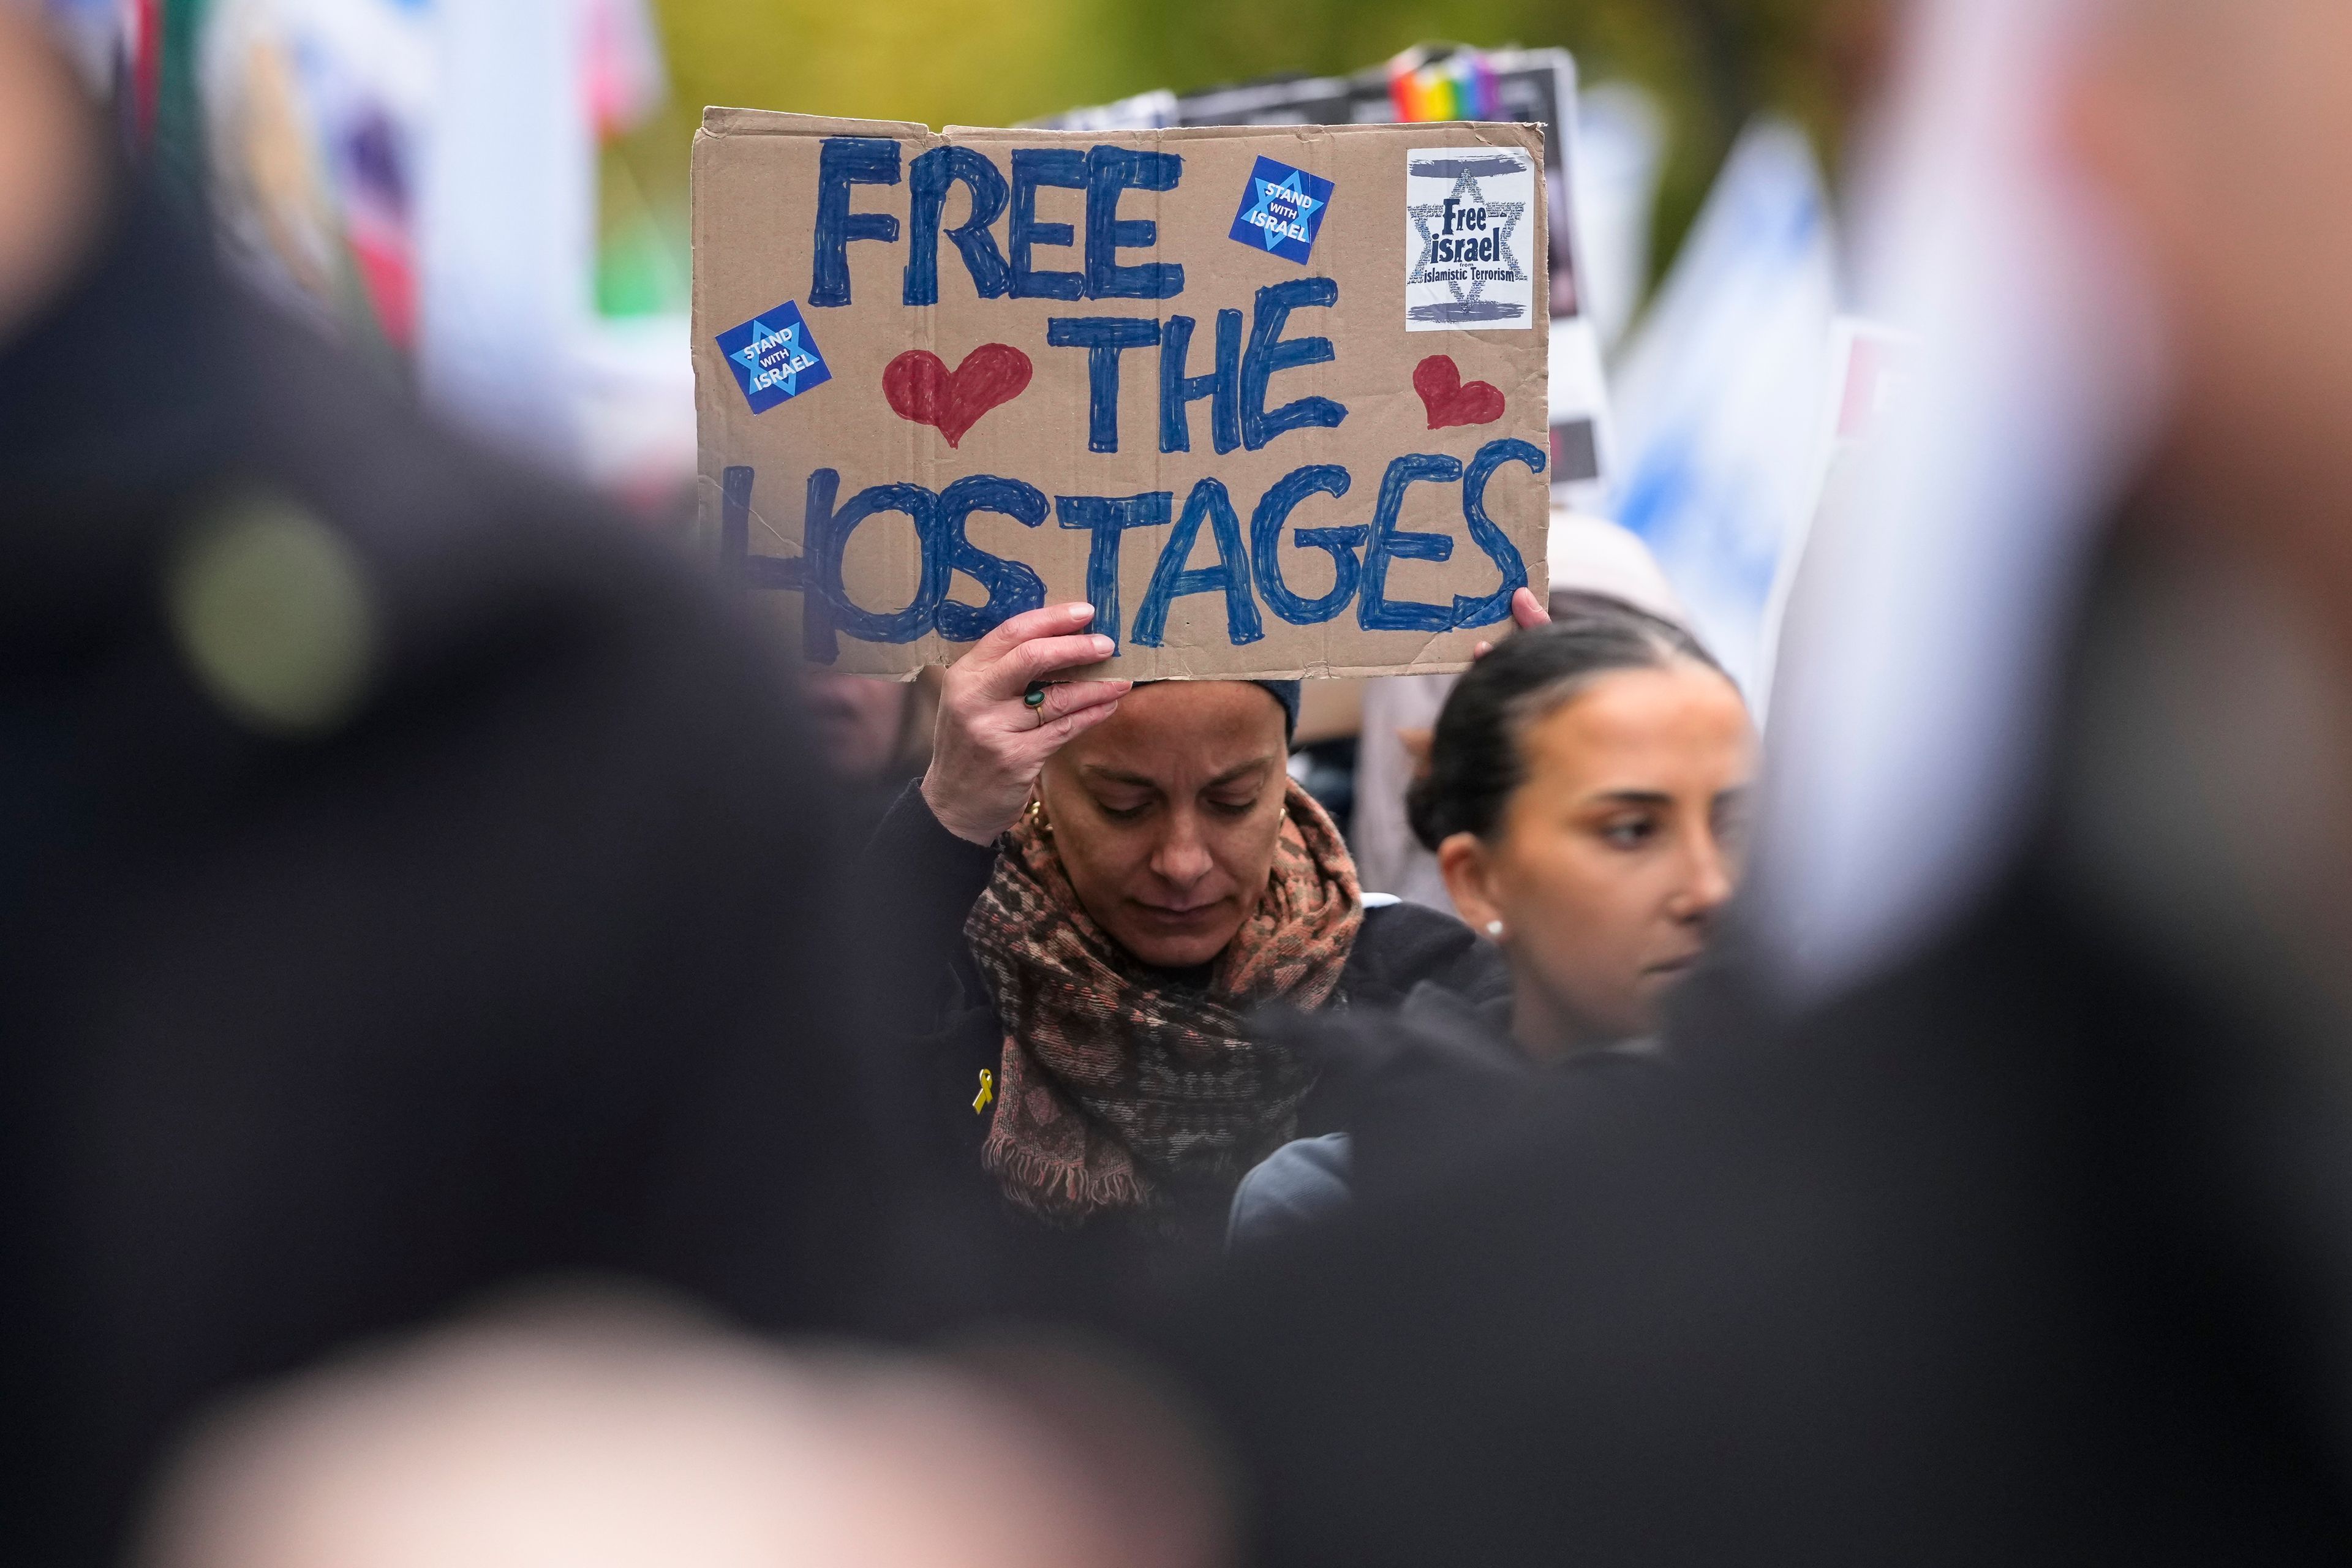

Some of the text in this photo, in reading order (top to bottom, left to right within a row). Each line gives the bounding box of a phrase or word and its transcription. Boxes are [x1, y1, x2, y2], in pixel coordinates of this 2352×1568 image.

[1265, 183, 1312, 208] STAND
[1270, 202, 1297, 219] WITH
[809, 136, 1184, 306] FREE
[1250, 210, 1306, 243] ISRAEL
[1442, 198, 1487, 235] Free
[1430, 227, 1501, 264] israel
[1423, 267, 1515, 283] islamistic Terrorism
[744, 328, 793, 359] STAND
[760, 348, 790, 368] WITH
[753, 353, 815, 391] ISRAEL
[1047, 277, 1348, 454] THE
[722, 438, 1547, 665] HOSTAGES
